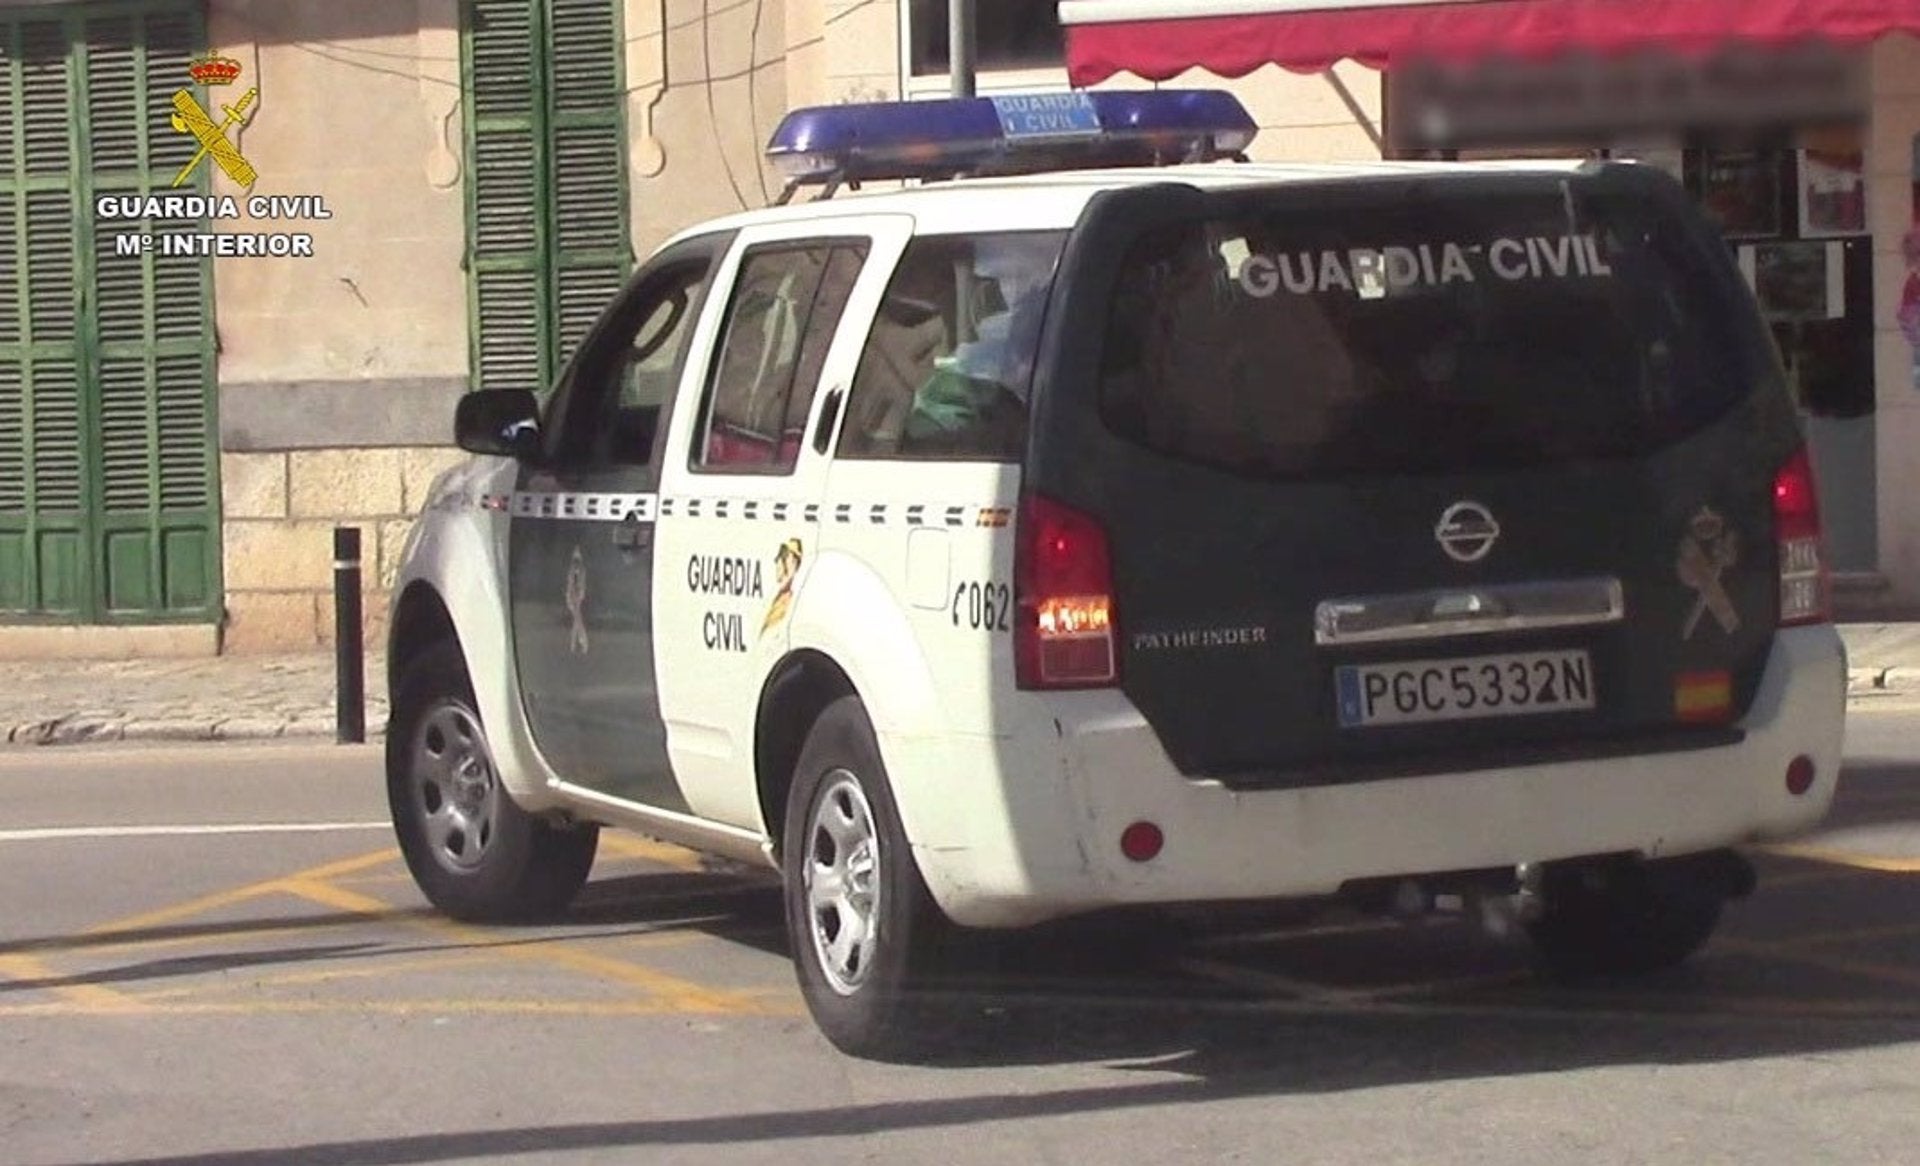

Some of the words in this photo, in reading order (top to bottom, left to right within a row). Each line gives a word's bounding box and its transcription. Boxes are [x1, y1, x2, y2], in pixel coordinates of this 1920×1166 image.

[1000, 93, 1093, 113] GUARDIA
[1026, 113, 1078, 132] CIVIL
[1240, 242, 1475, 298] GUARDIA
[1489, 234, 1612, 280] CIVIL
[687, 554, 763, 599] GUARDIA
[969, 581, 1009, 632] 062
[703, 611, 747, 652] CIVIL
[1134, 626, 1266, 650] PATHFINDER
[1364, 657, 1588, 717] PGC5332N
